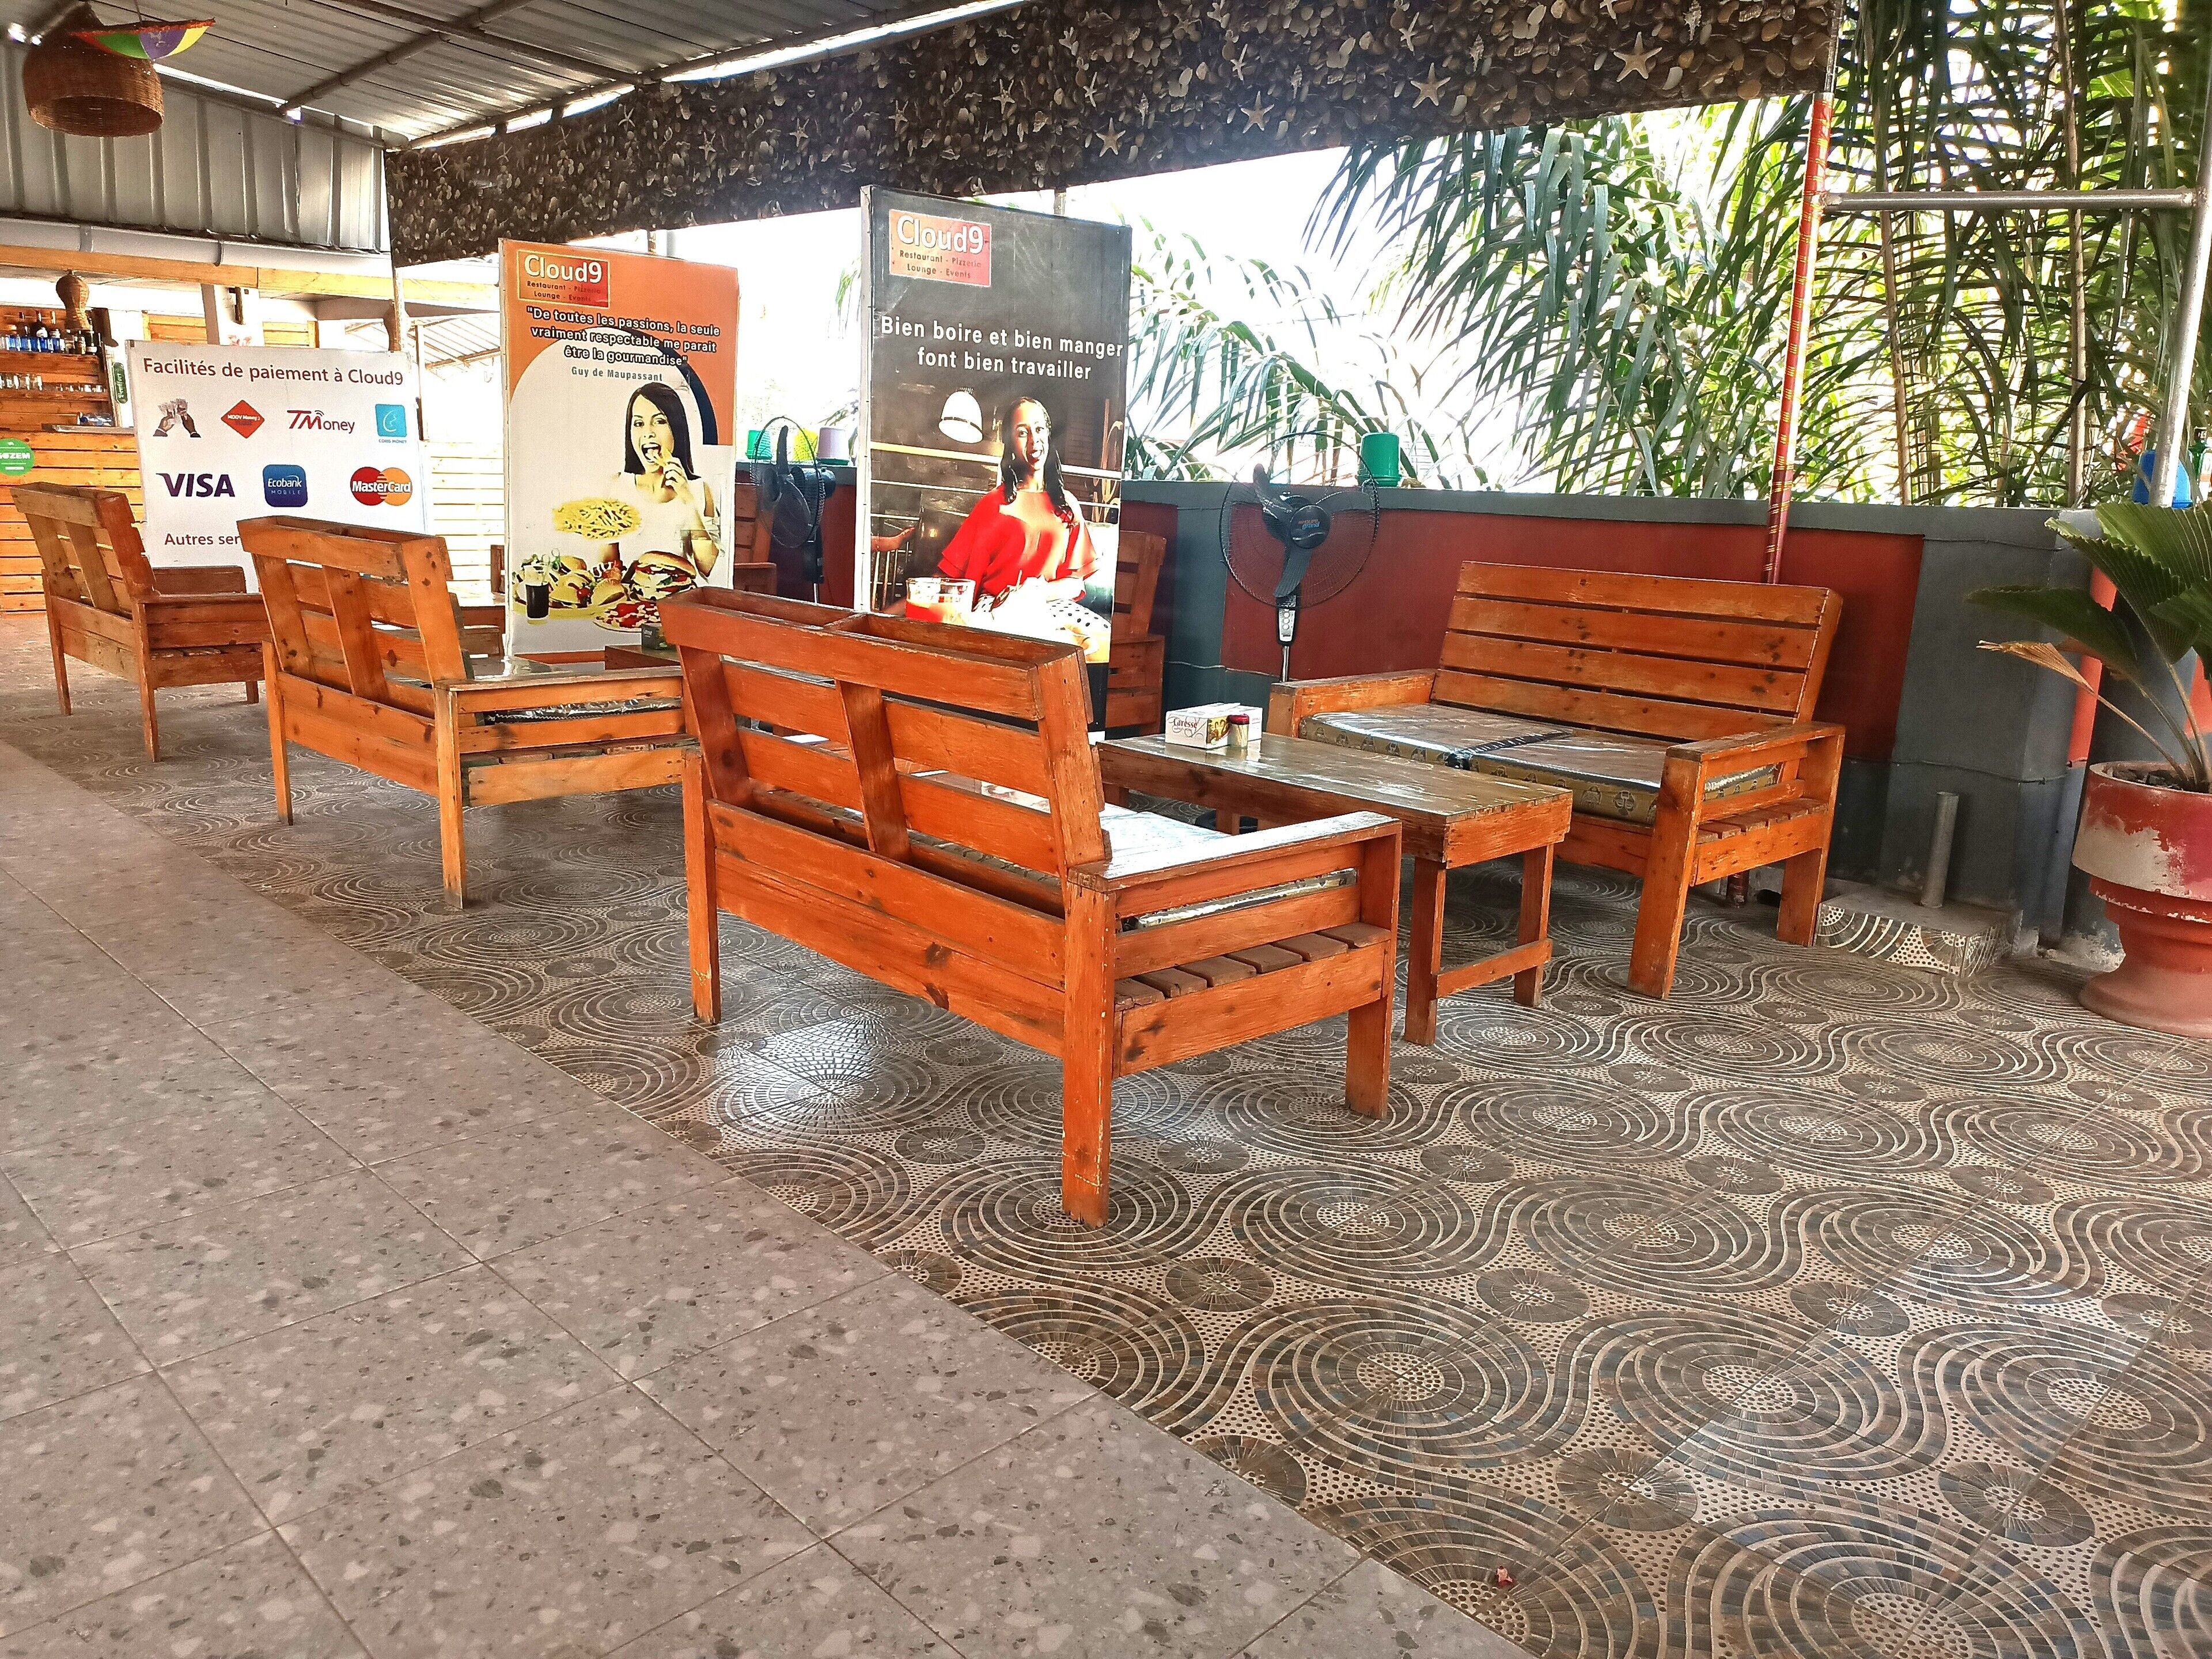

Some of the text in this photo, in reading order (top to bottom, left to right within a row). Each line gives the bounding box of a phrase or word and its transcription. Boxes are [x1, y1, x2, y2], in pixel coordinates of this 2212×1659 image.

[897, 215, 984, 254] Cloud9
[900, 249, 943, 262] Restaurant
[524, 254, 602, 283] Cloud9
[907, 263, 937, 275] Lounge
[946, 269, 971, 279] Events
[527, 280, 566, 290] Restaurant
[533, 290, 560, 300] Lounge
[553, 309, 594, 324] toutes
[597, 313, 615, 326] les
[618, 317, 674, 333] passions,
[676, 321, 687, 333] la
[690, 324, 721, 336] seule
[531, 326, 717, 353] vraiment respectable me parait
[881, 316, 1123, 359] Bien boire et bien manger
[564, 346, 688, 366] être la gourmandise"
[917, 346, 1092, 380] font bien travailler
[143, 358, 403, 385] Facilités de paiement à Cloud9
[571, 366, 663, 381] Guy de Maupassant
[156, 473, 235, 498] VISA
[267, 476, 302, 488] Ecobank
[351, 480, 411, 493] MasterCard
[164, 533, 214, 545] Autres
